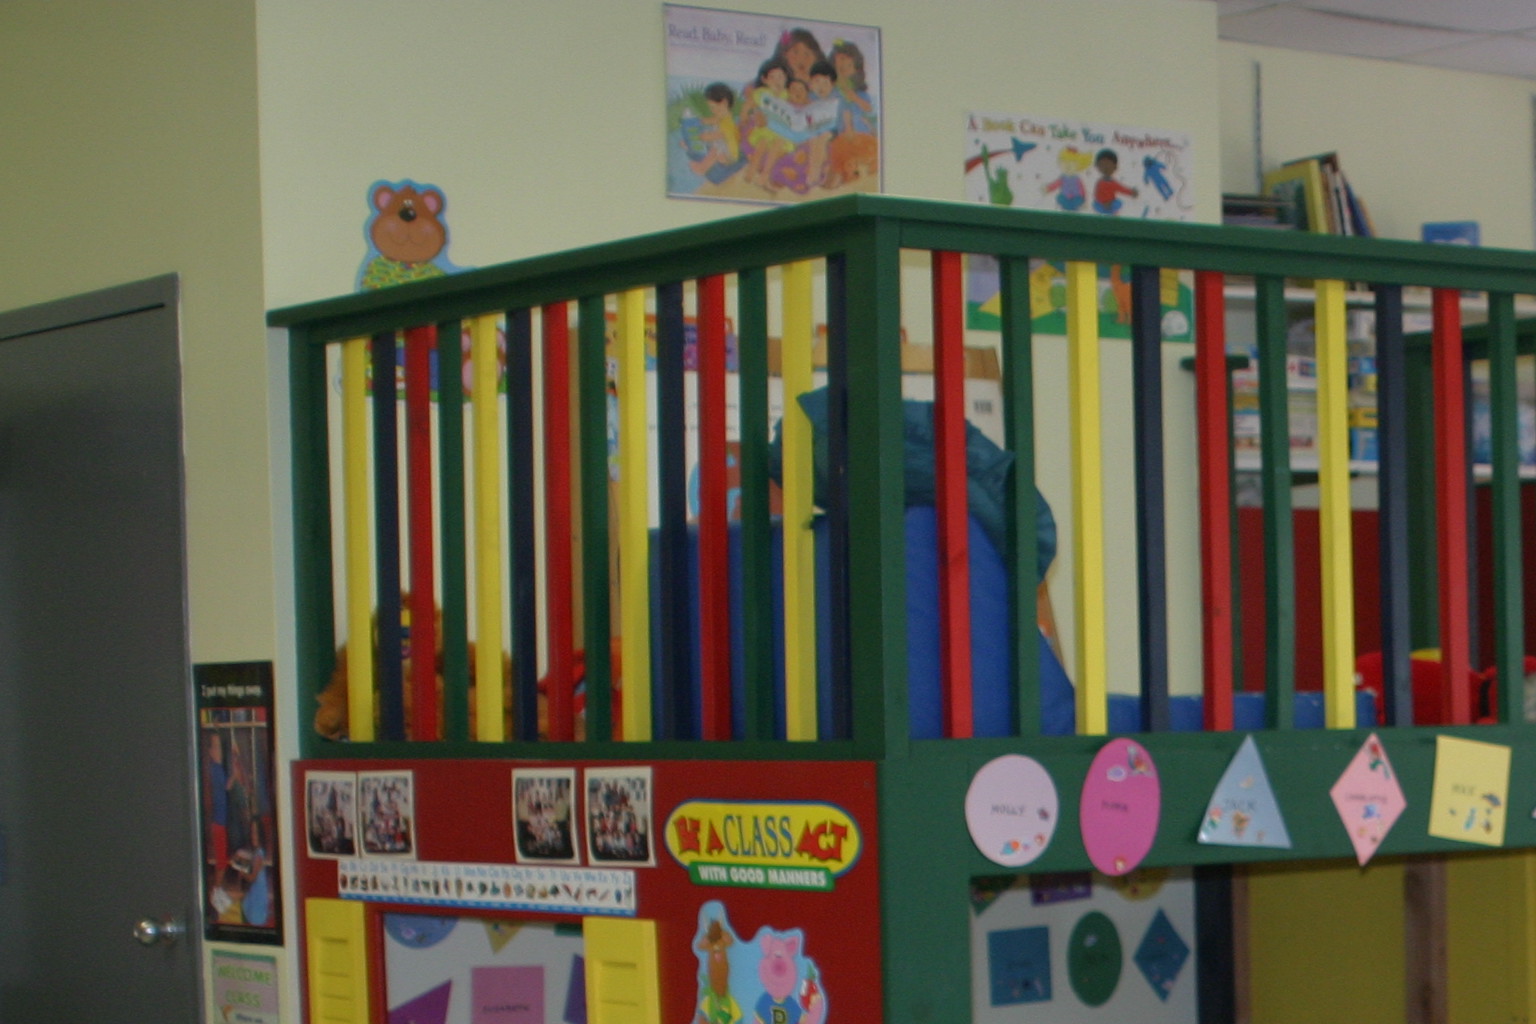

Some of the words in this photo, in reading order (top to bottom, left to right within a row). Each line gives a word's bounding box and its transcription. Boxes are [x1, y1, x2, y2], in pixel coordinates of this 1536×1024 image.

[968, 114, 978, 131] A
[1019, 119, 1046, 136] Can
[1048, 123, 1077, 140] Take
[1081, 128, 1106, 144] You
[673, 815, 701, 856] BE
[706, 818, 724, 855] A
[723, 813, 795, 859] CLASS
[796, 819, 848, 863] ACT
[698, 864, 728, 883] WITH
[729, 866, 766, 884] GOOD
[767, 868, 827, 887] MANNERS
